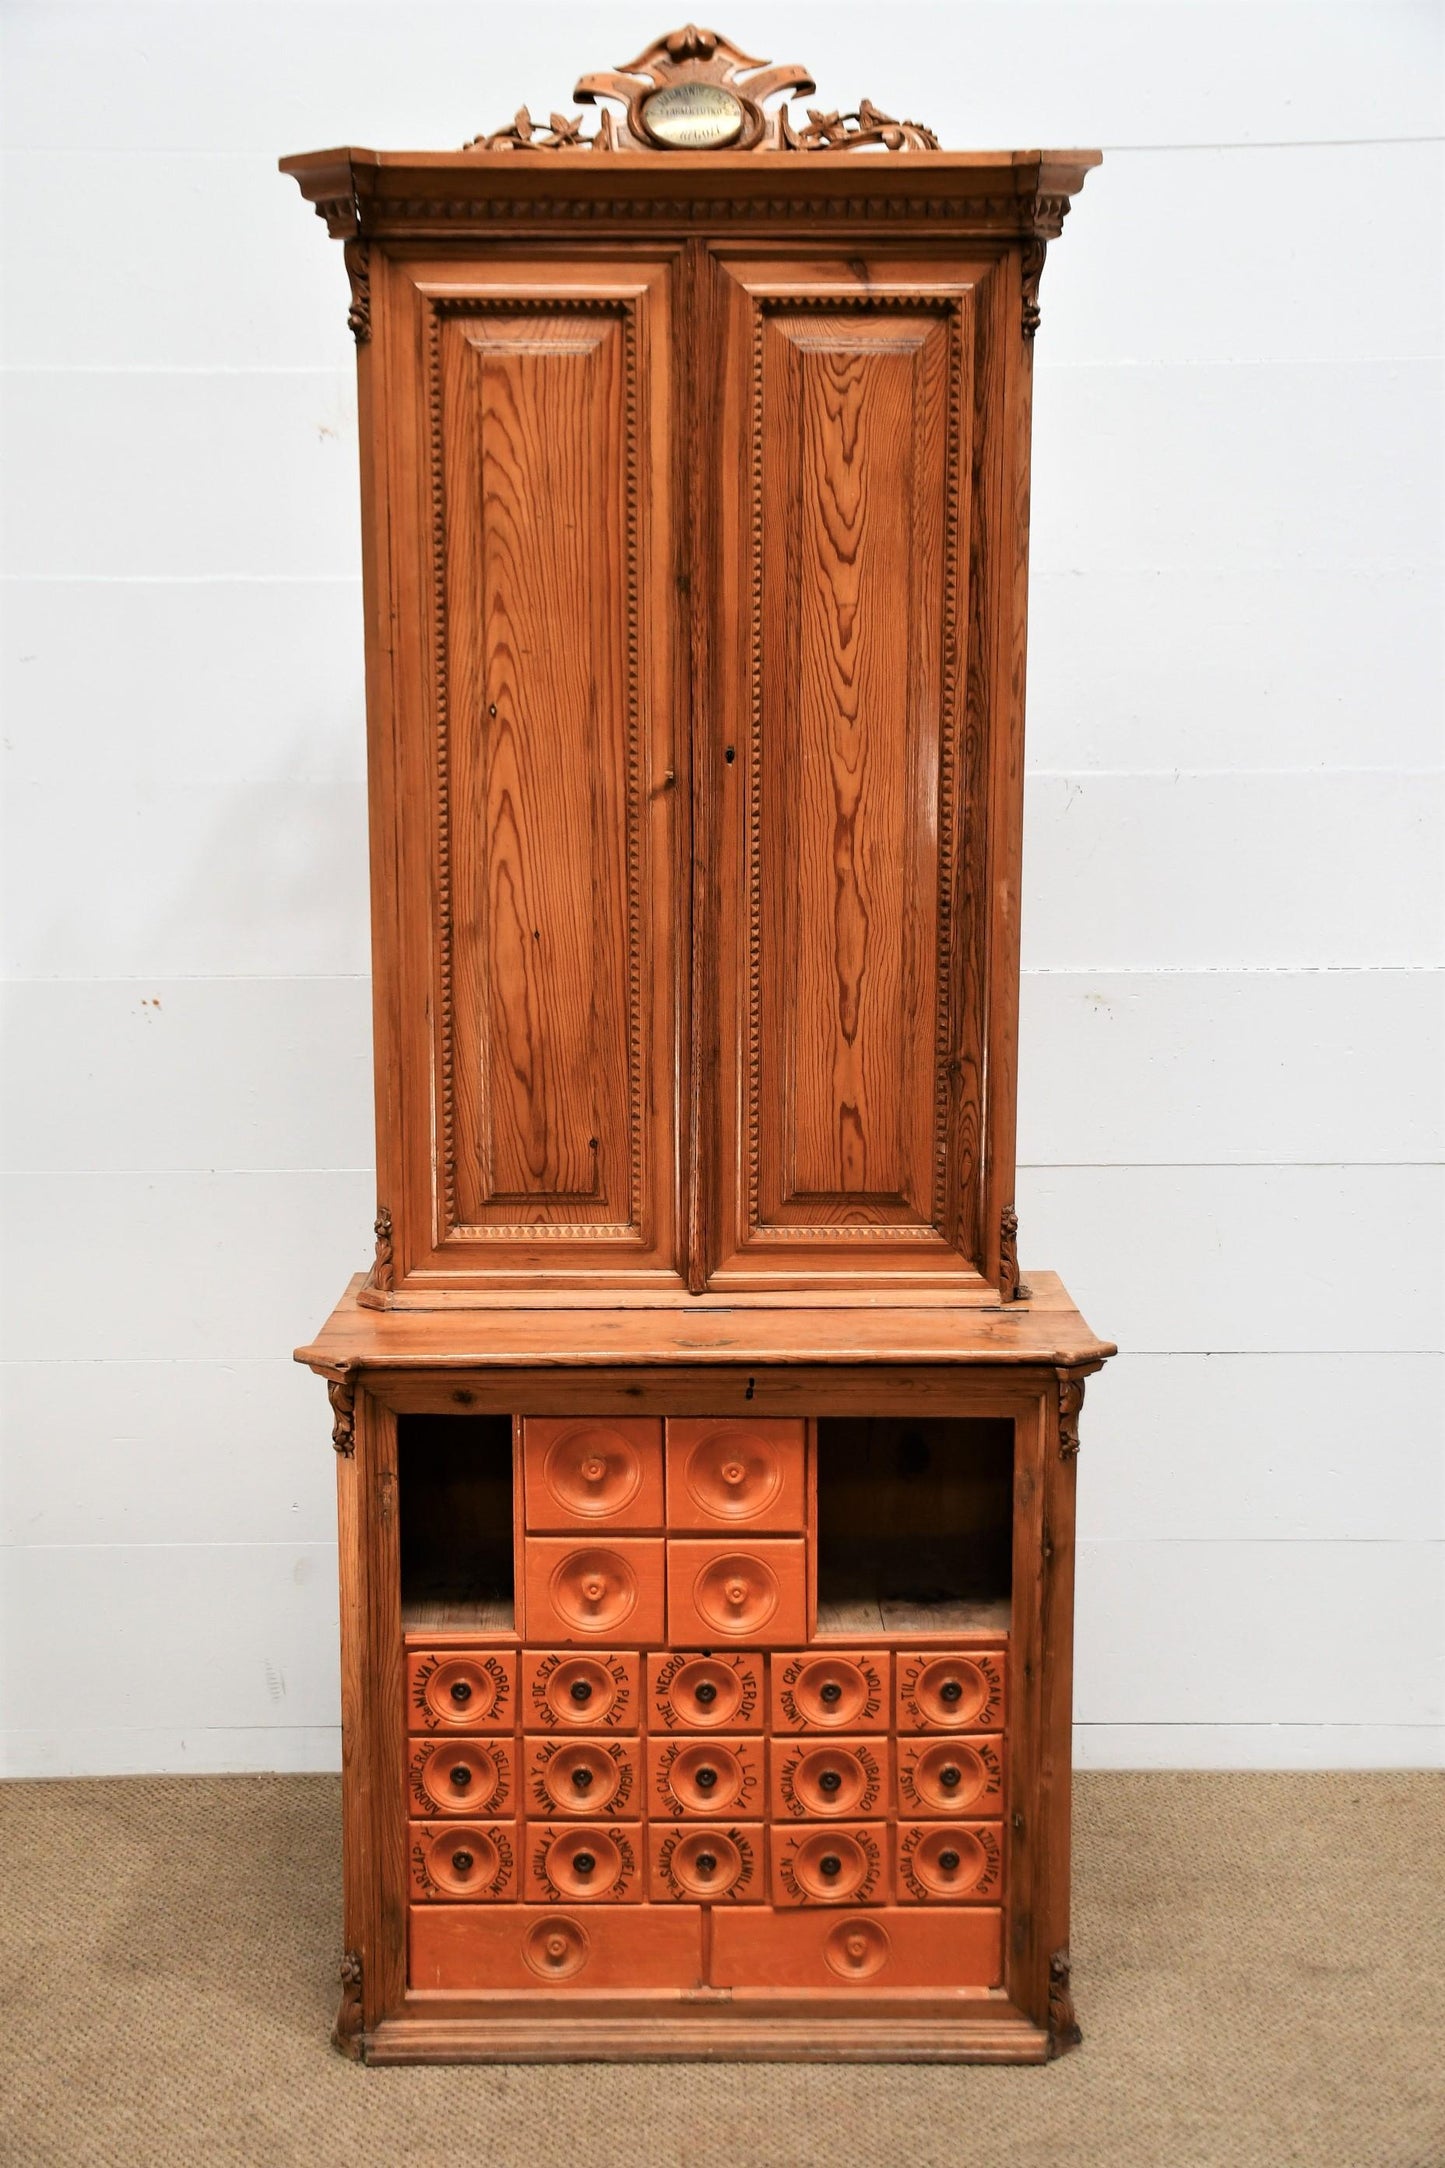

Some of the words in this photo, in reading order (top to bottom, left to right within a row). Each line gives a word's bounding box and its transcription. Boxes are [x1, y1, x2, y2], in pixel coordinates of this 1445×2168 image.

[536, 1654, 561, 1680] SEN
[604, 1655, 617, 1668] Y
[731, 1656, 745, 1669] Y
[413, 1665, 434, 1708] MALVA
[427, 1655, 440, 1668] Y
[611, 1665, 629, 1685] DE
[656, 1655, 686, 1695] NEGRO
[901, 1668, 919, 1700] TILO
[914, 1656, 927, 1668] Y
[532, 1682, 546, 1697] DE
[780, 1689, 809, 1731] LINOSA
[856, 1656, 870, 1668] Y
[656, 1701, 679, 1729] THE
[536, 1741, 562, 1763] SAL
[607, 1743, 628, 1762] DE
[734, 1744, 747, 1756] Y
[792, 1745, 805, 1759] Y
[905, 1748, 919, 1759] Y
[410, 1741, 441, 1816] ADORMIDERAS
[486, 1741, 498, 1753] Y
[530, 1766, 545, 1776] Y
[780, 1758, 806, 1817] GENCIANA
[900, 1767, 921, 1809] LUISA
[421, 1827, 434, 1839] Y
[544, 1826, 557, 1839] Y
[659, 1839, 676, 1878] SAUCO
[671, 1828, 683, 1840] Y
[785, 1837, 800, 1849] Y
